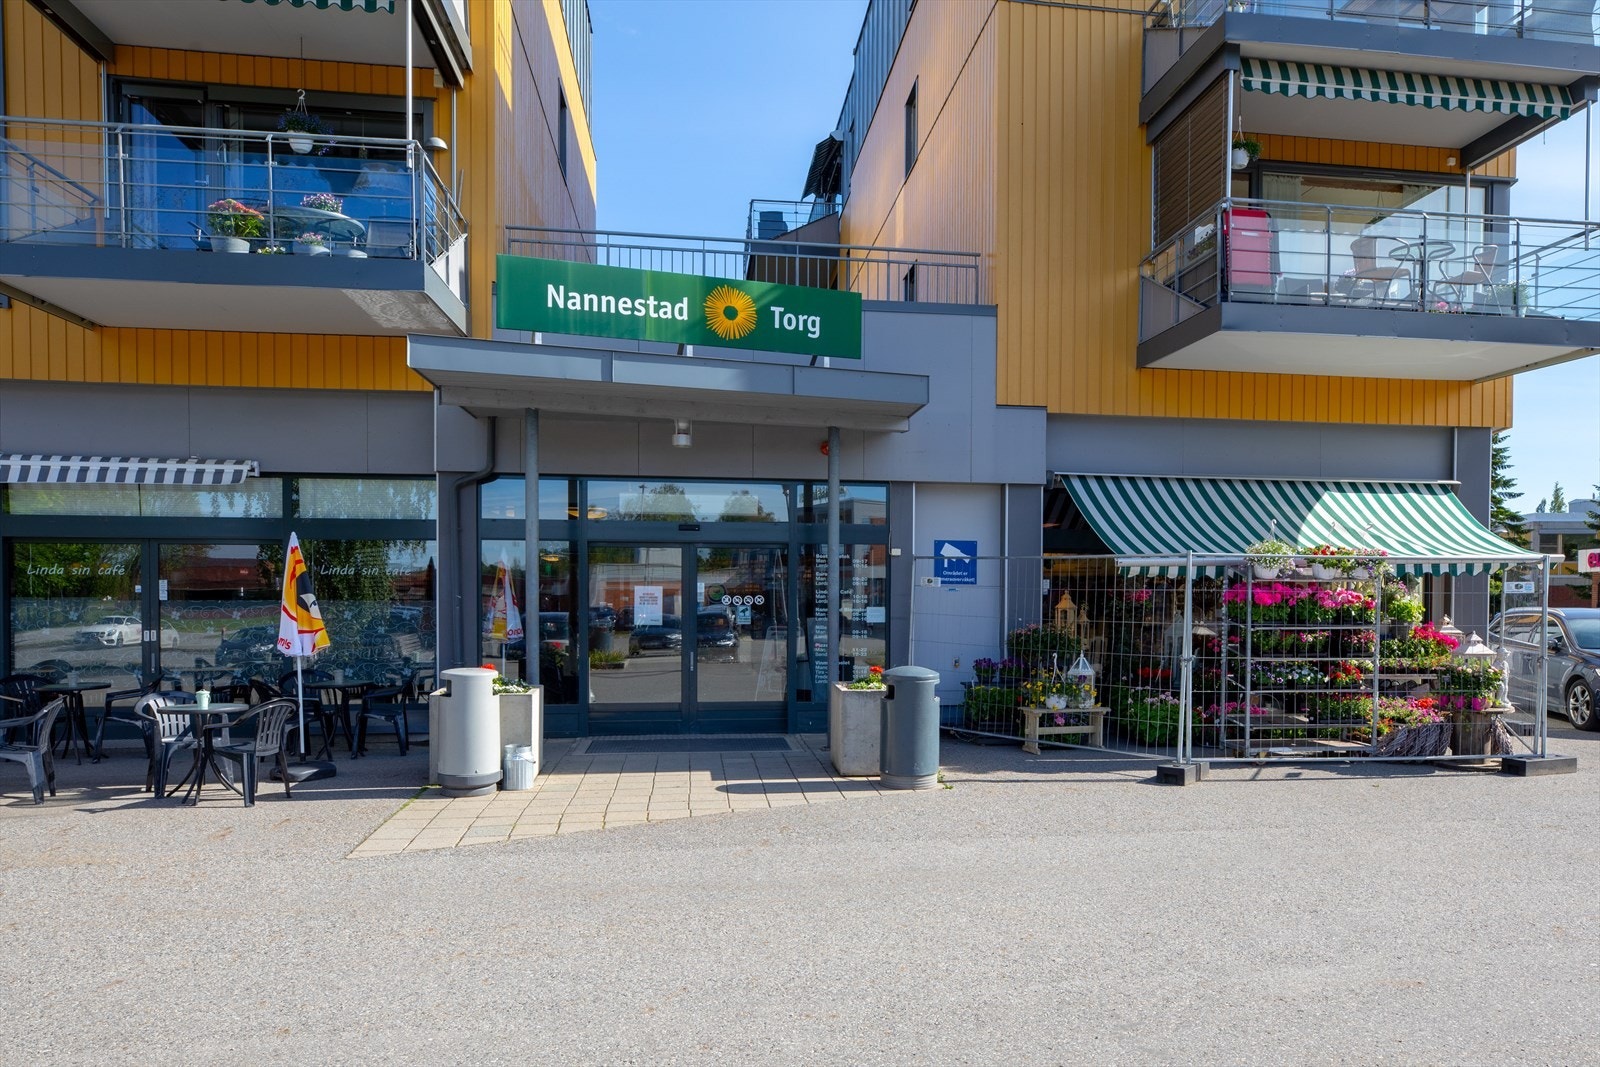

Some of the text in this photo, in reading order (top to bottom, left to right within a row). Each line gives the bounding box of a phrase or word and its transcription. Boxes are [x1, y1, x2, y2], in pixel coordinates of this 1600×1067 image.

[547, 284, 821, 338] Nannestad Torg
[27, 563, 126, 576] Linda sin café
[320, 564, 355, 575] Linda
[361, 566, 379, 575] sin
